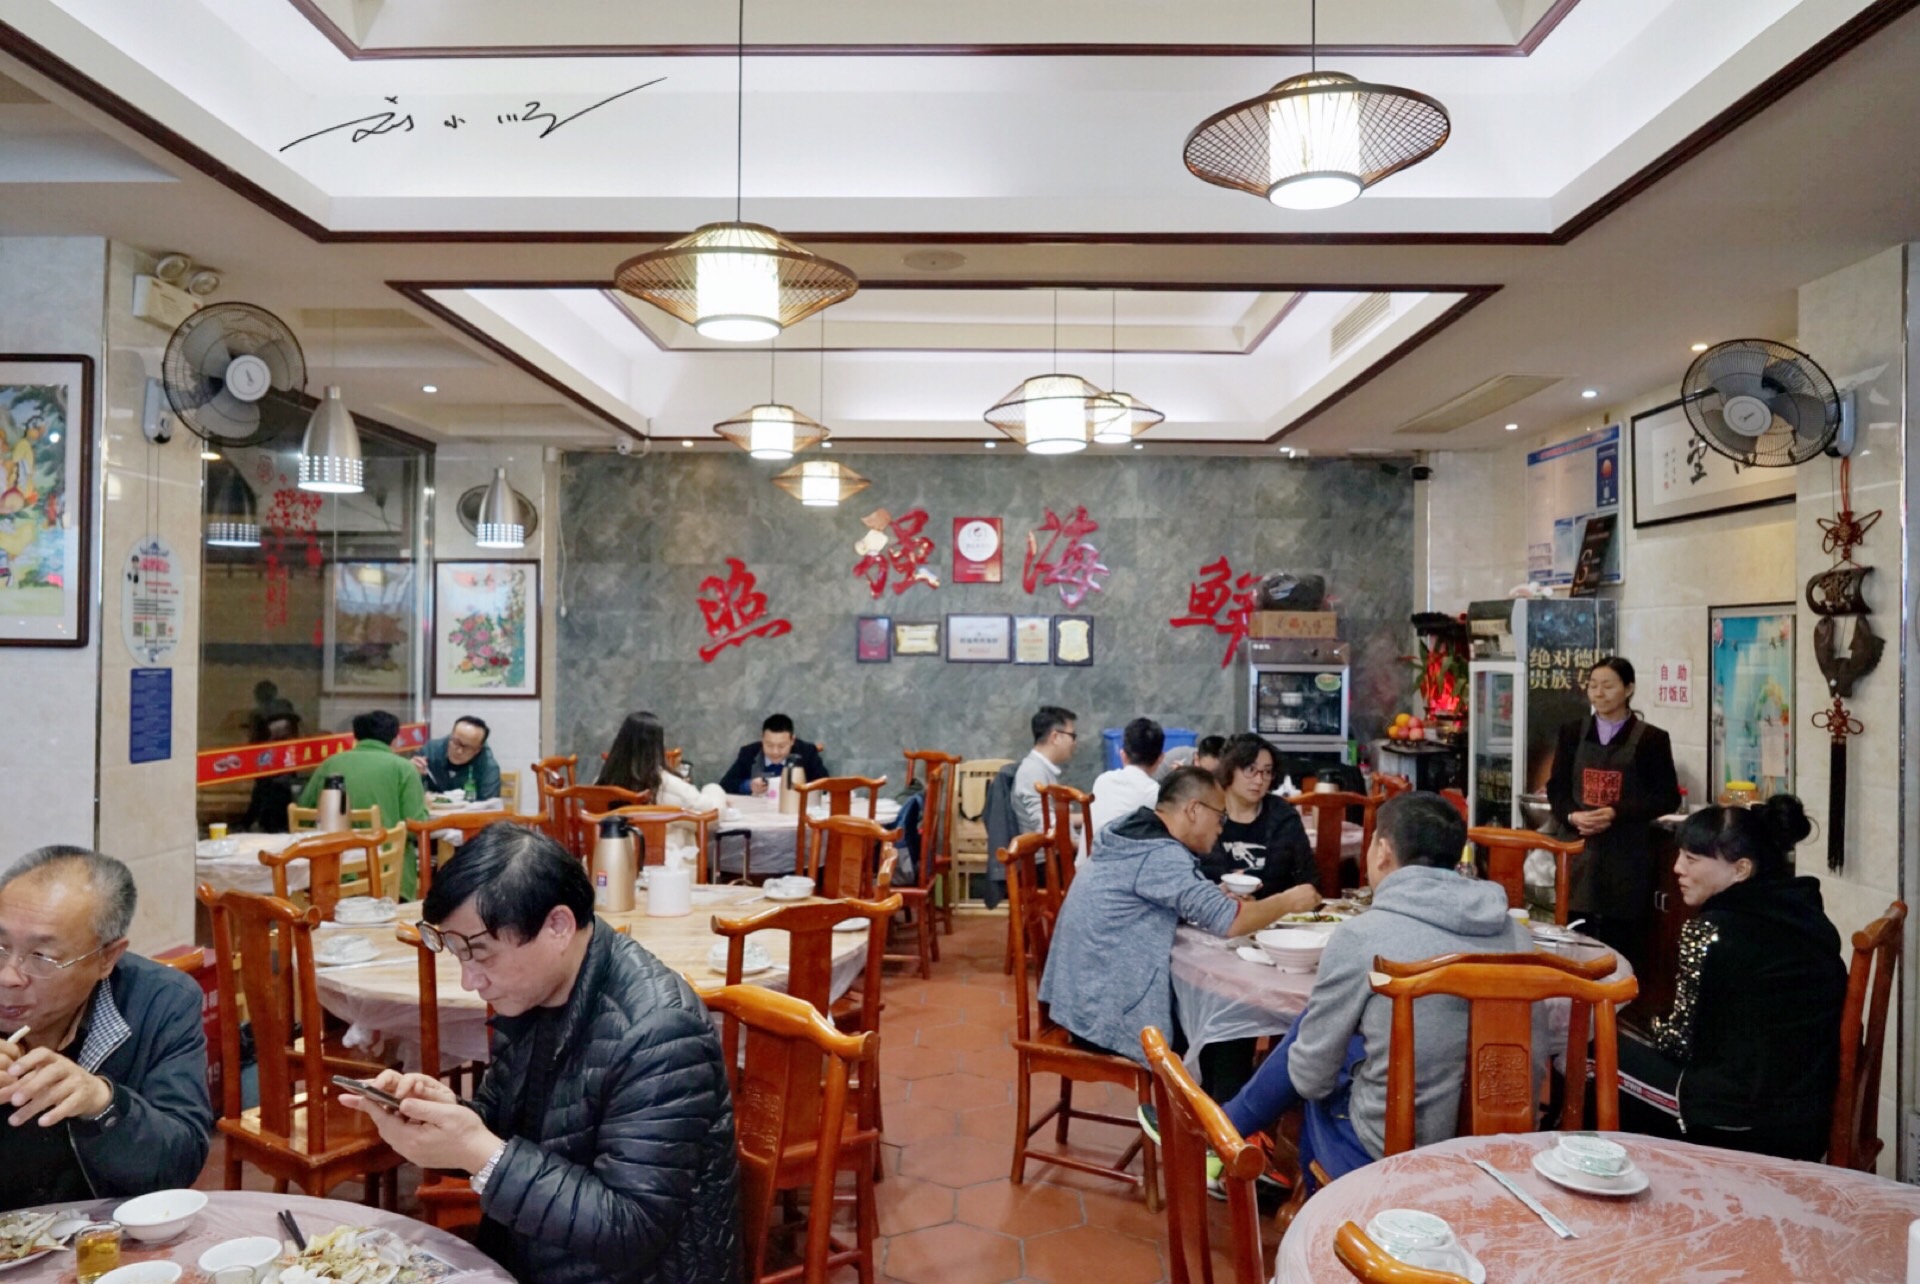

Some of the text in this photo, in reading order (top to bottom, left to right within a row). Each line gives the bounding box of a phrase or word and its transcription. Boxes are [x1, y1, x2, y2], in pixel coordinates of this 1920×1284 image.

[1659, 664, 1688, 681] 自助
[1658, 685, 1688, 703] 打饭区
